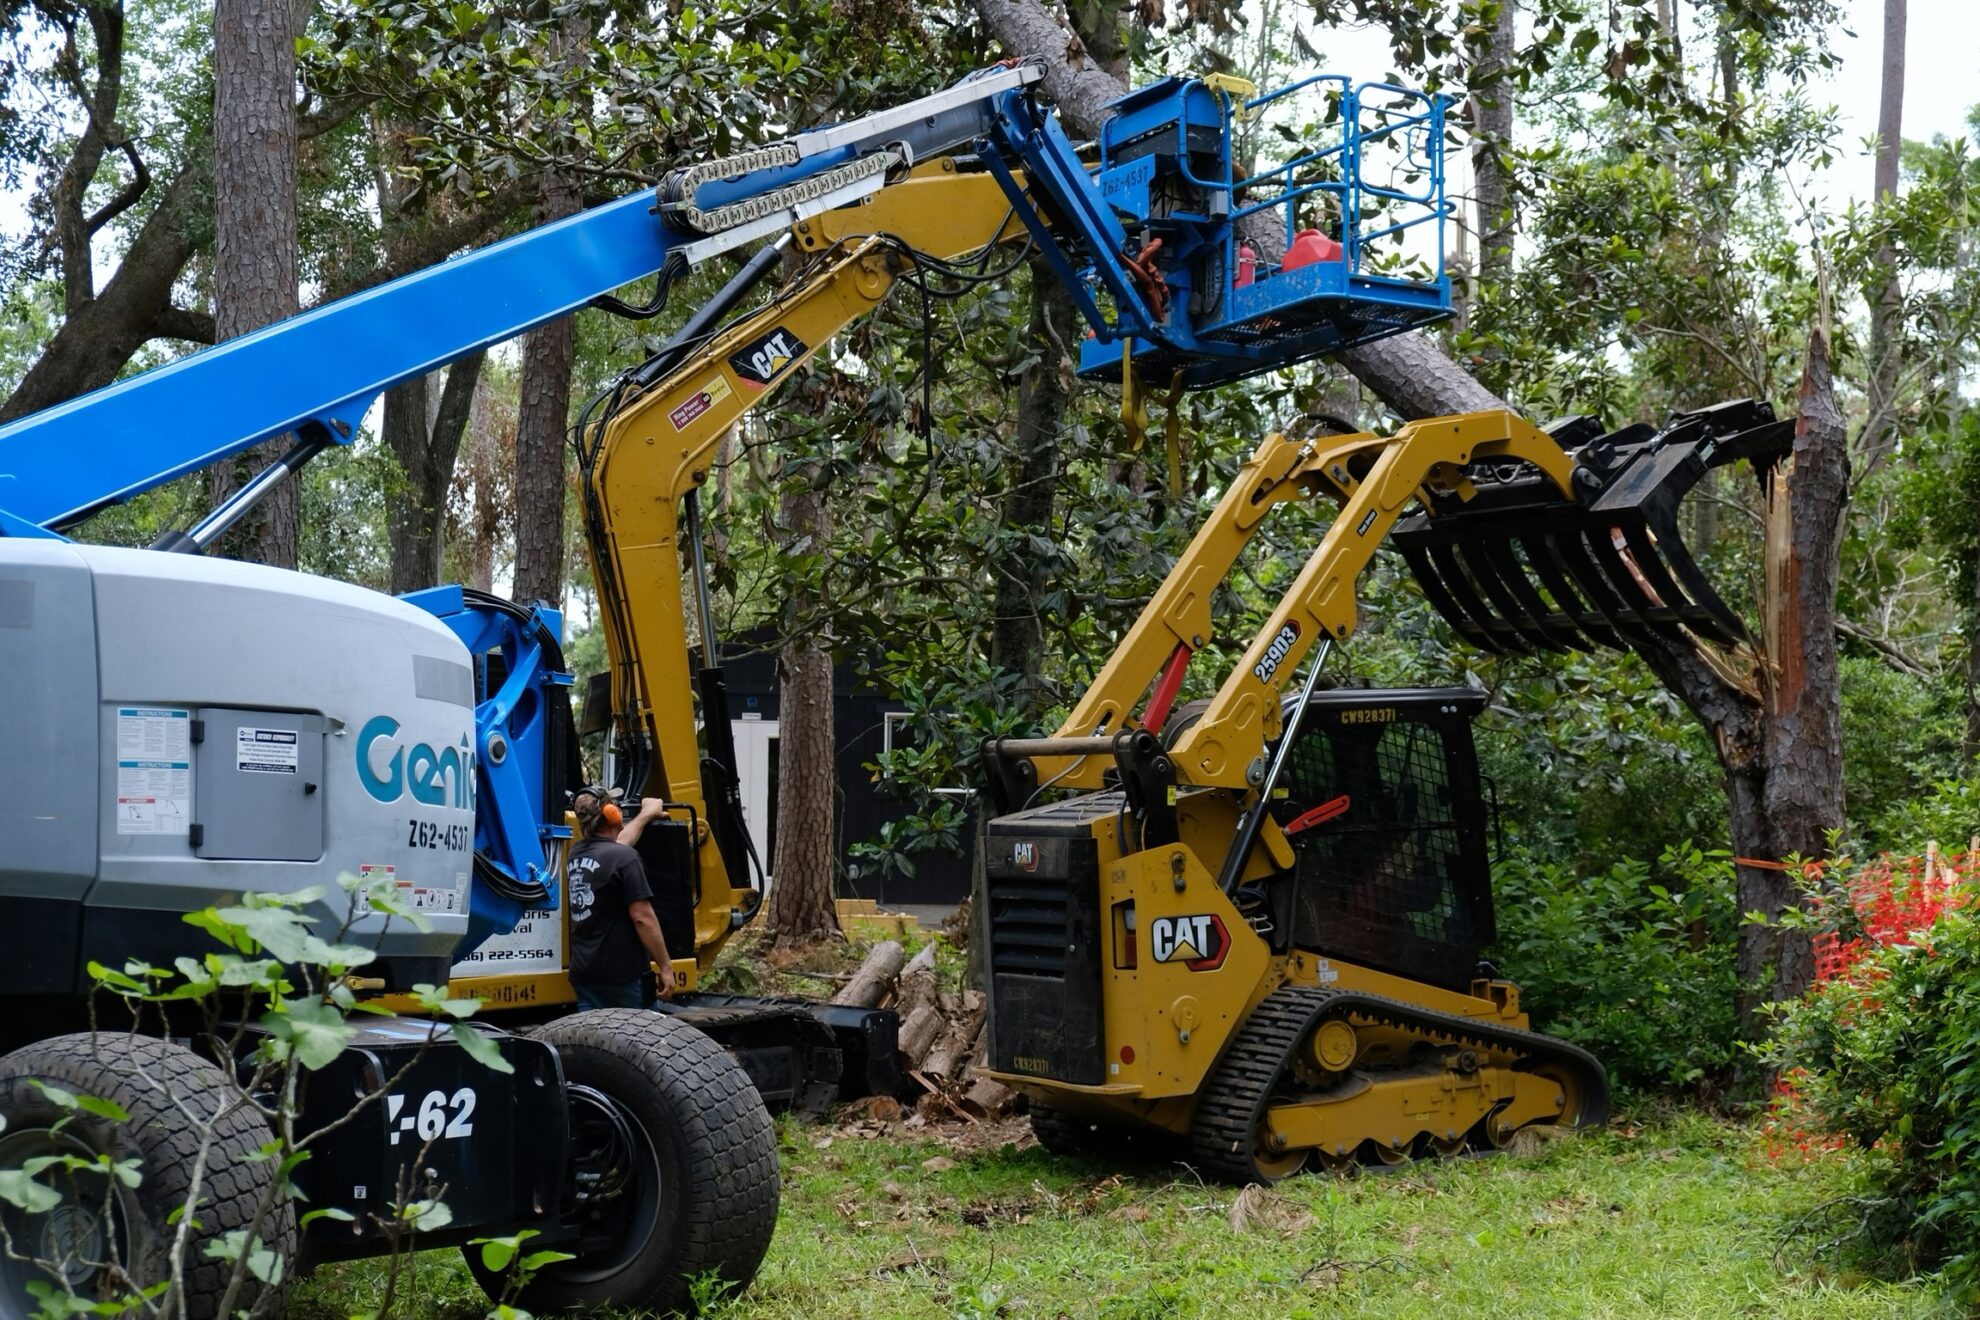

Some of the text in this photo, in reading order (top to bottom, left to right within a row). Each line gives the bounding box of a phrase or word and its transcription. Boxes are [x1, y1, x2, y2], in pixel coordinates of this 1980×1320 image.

[1102, 165, 1149, 198] Z62-4537
[751, 332, 793, 379] CAT
[683, 399, 700, 413] Power
[1254, 626, 1297, 683] 259D3
[408, 819, 468, 852] Z62-4537
[1014, 843, 1033, 864] CAT
[512, 922, 532, 934] val
[1153, 916, 1211, 962] CAT
[488, 949, 554, 961] 222-5564
